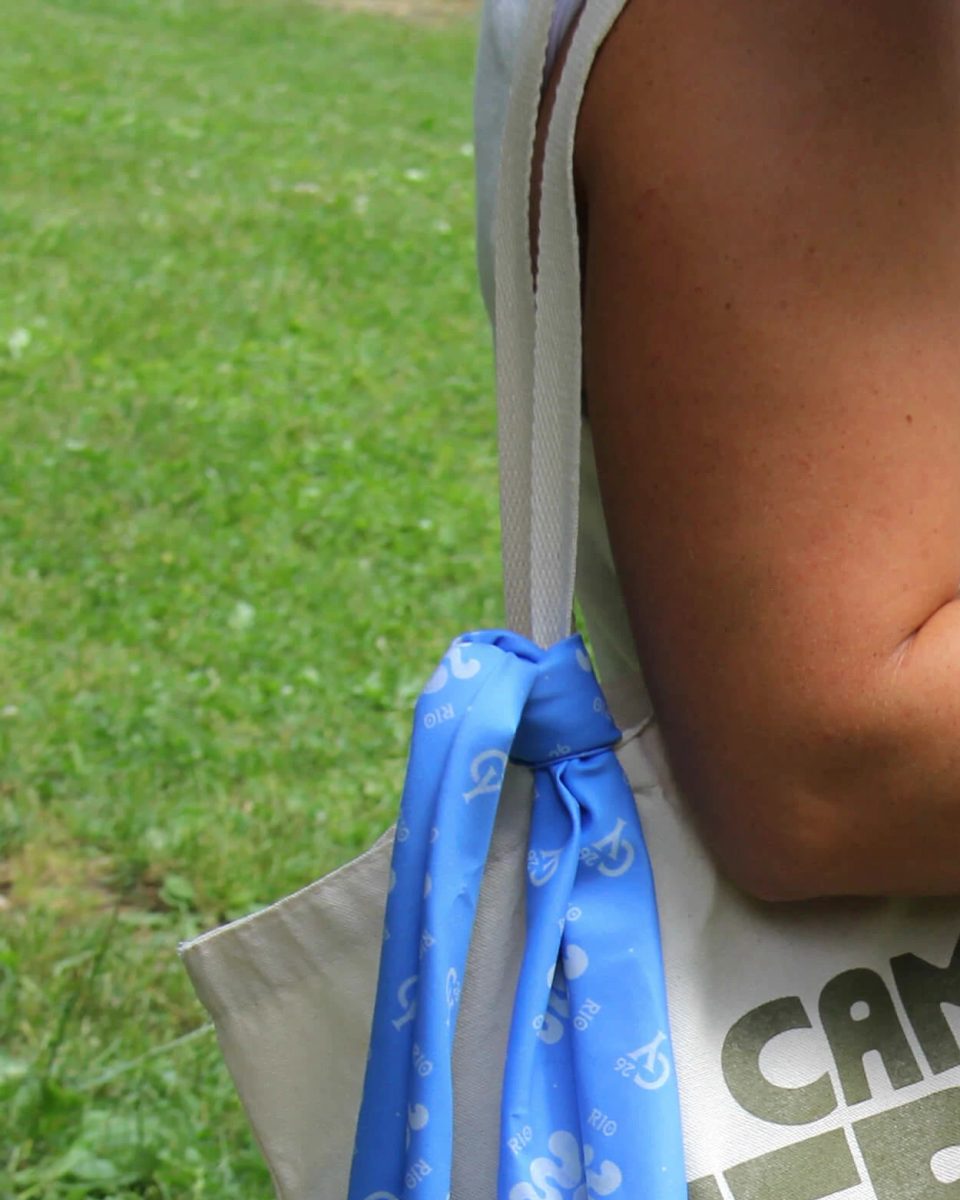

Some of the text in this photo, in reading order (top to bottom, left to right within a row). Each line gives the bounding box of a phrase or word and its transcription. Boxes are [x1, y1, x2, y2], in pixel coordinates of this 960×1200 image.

[423, 703, 455, 729] RIO
[573, 998, 602, 1032] RIO
[614, 1057, 637, 1078] 26
[587, 1108, 618, 1138] RIO
[507, 1125, 534, 1156] RIO
[404, 1158, 434, 1190] RIO
